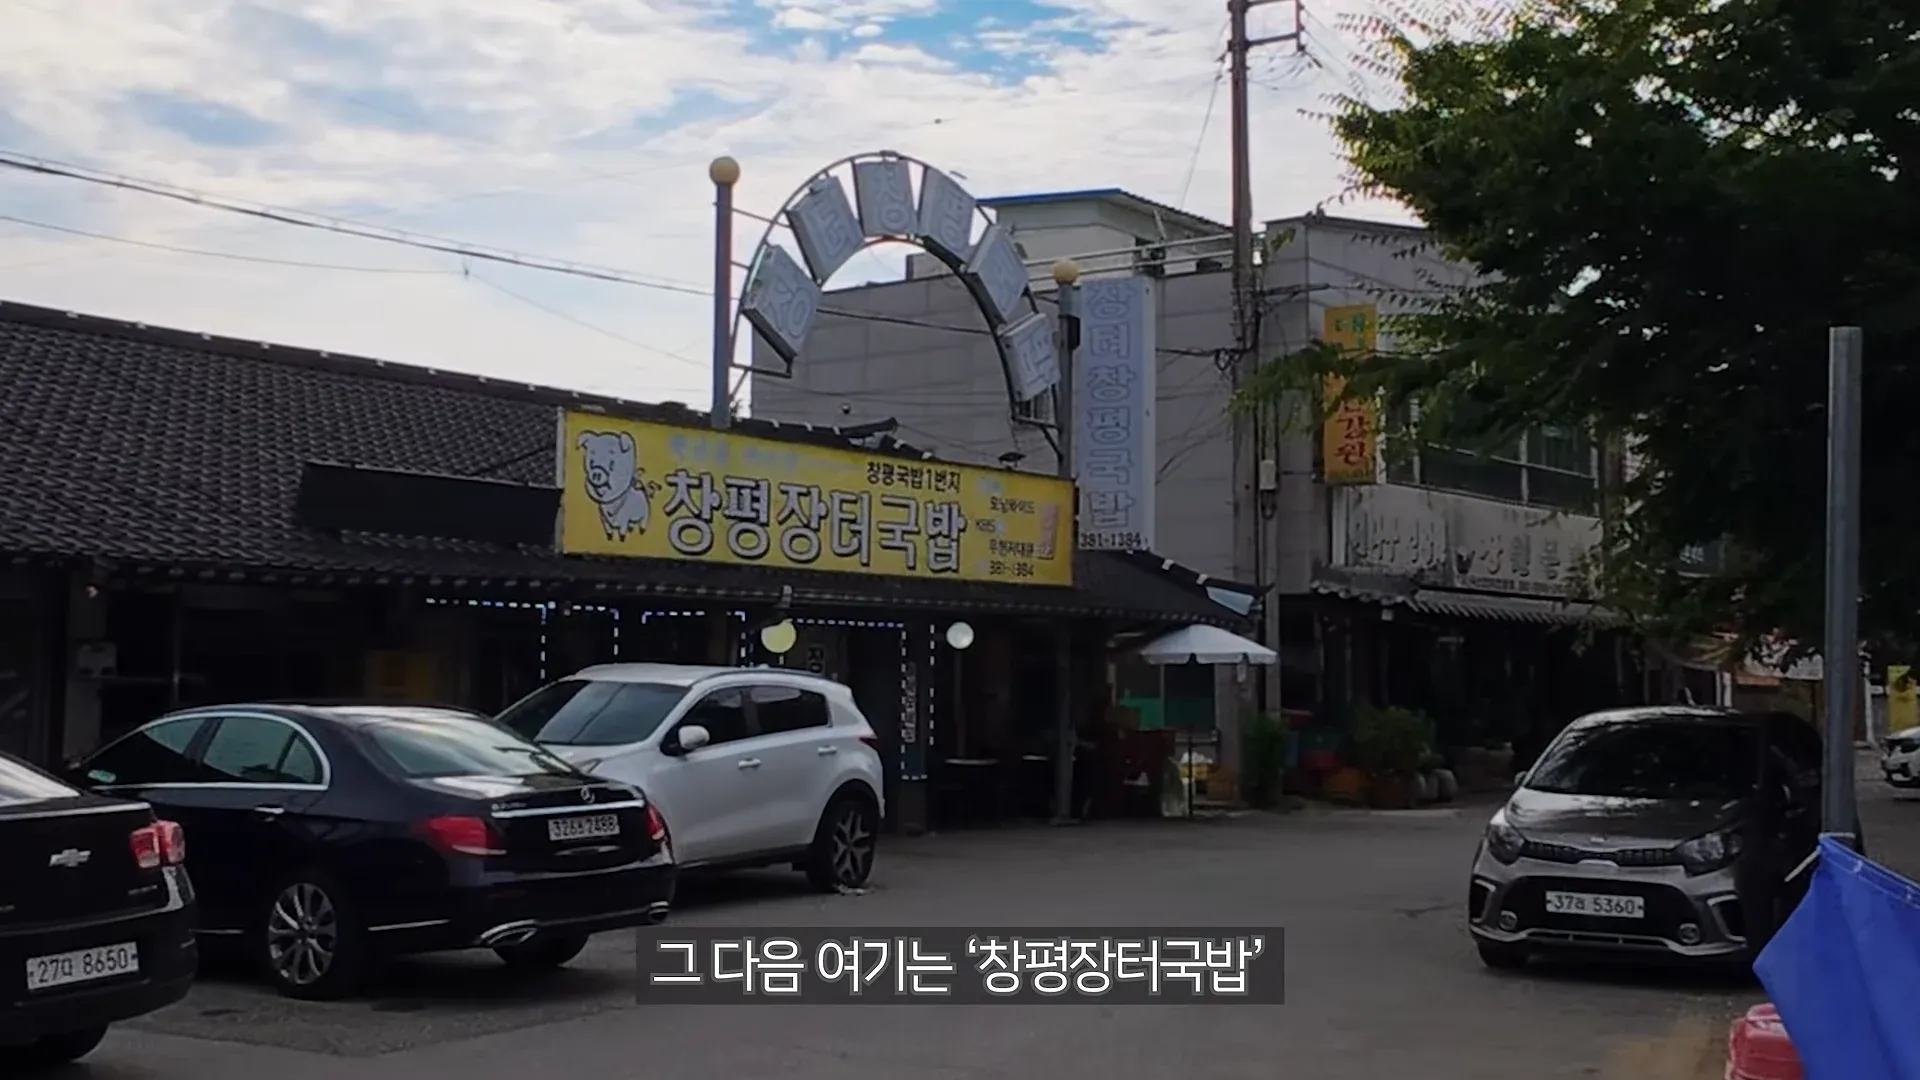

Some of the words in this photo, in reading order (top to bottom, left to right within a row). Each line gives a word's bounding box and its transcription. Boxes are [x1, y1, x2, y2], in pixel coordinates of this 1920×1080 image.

[866, 461, 961, 494] 창평국밥1번지
[663, 467, 967, 574] 창평장터국밥
[1080, 531, 1141, 548] 381-1384
[1593, 896, 1635, 915] 5360
[82, 947, 129, 975] 8650
